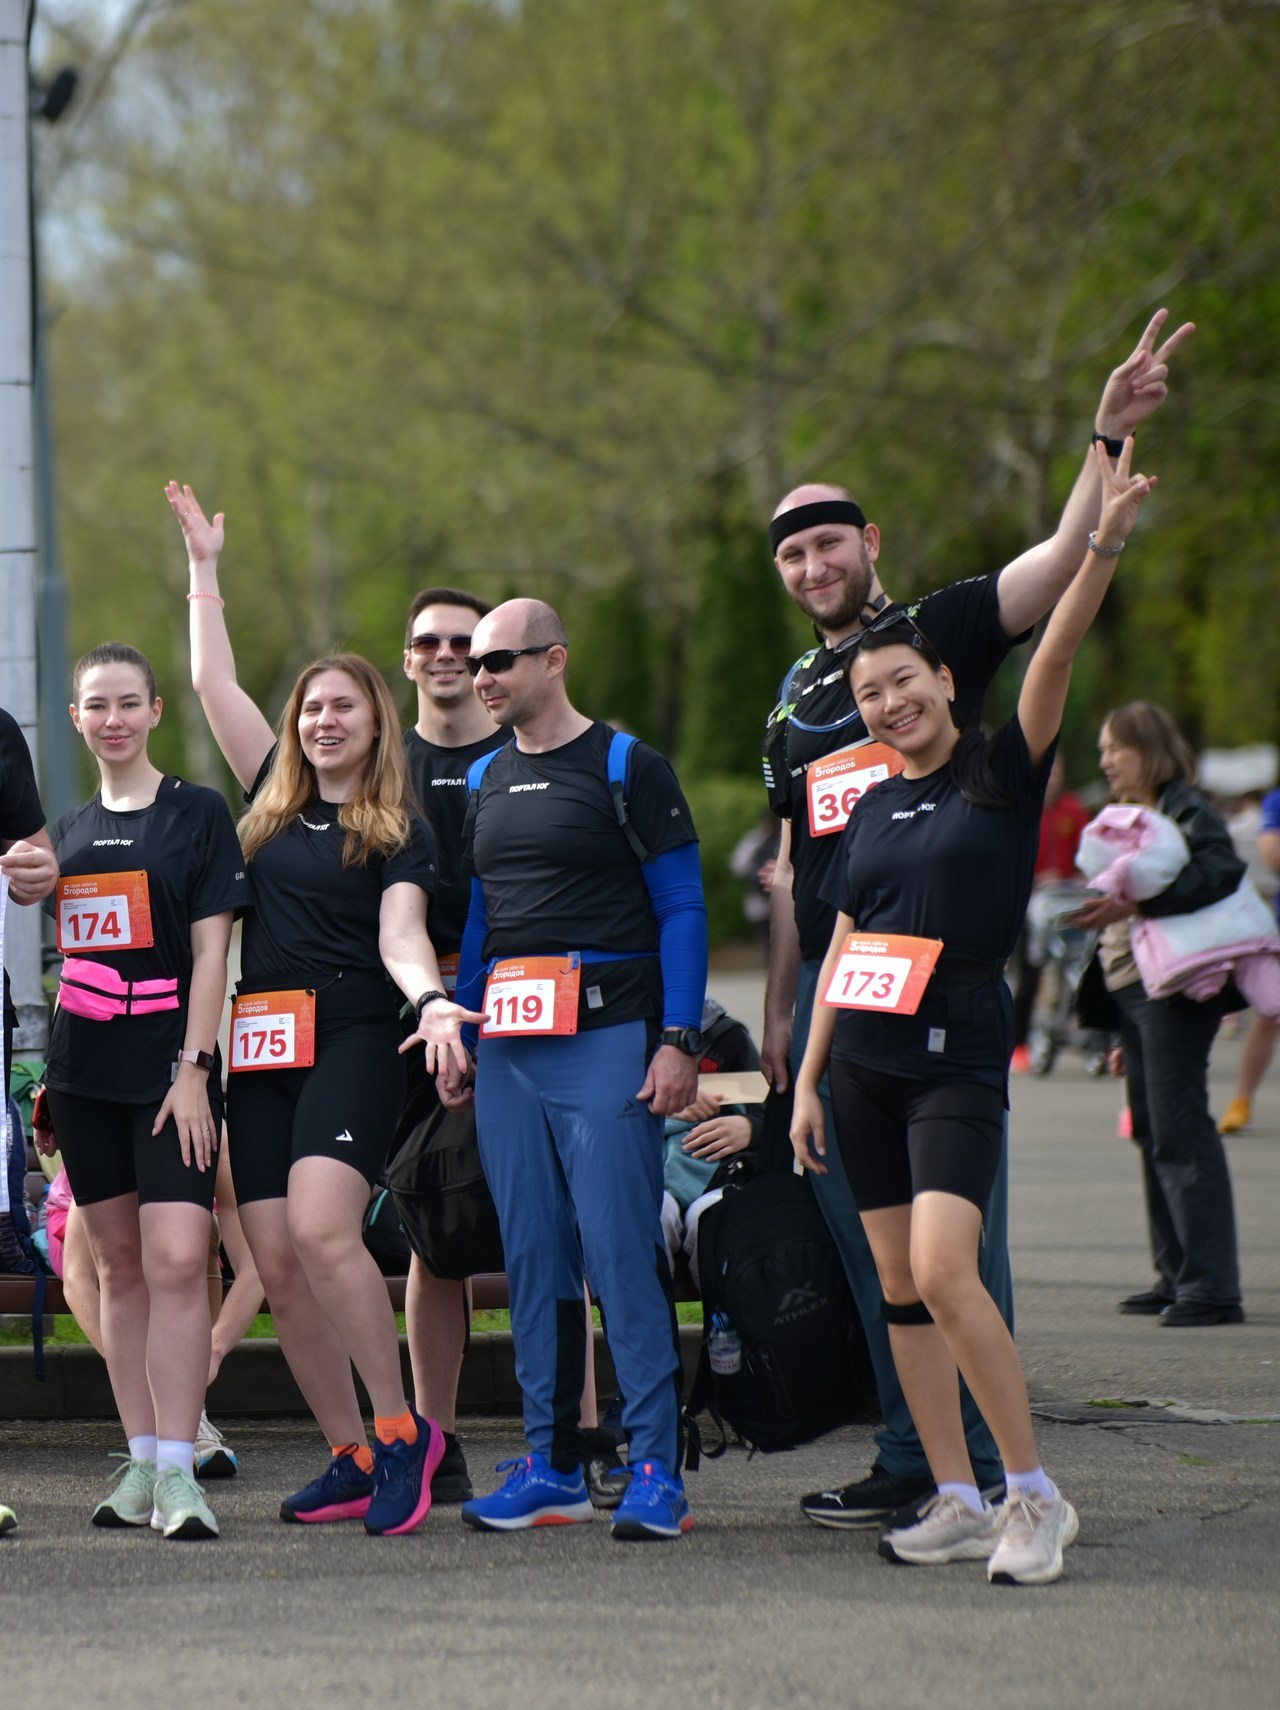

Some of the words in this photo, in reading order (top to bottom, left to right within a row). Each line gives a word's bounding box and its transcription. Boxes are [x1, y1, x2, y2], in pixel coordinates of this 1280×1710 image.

[822, 762, 856, 776] городов
[431, 778, 461, 787] ПОРТАЛ
[509, 783, 536, 793] ПОРТАЛ
[537, 782, 550, 790] ЮГ
[92, 838, 120, 847] ПОРТАЛ
[63, 885, 69, 895] 5
[69, 886, 98, 895] городов
[68, 911, 121, 941] 174
[493, 968, 498, 980] 5
[498, 969, 525, 979] городов
[842, 970, 895, 999] 173
[238, 1003, 243, 1014] 5
[242, 1004, 268, 1014] городов
[493, 995, 543, 1025] 119
[240, 1029, 287, 1059] 175
